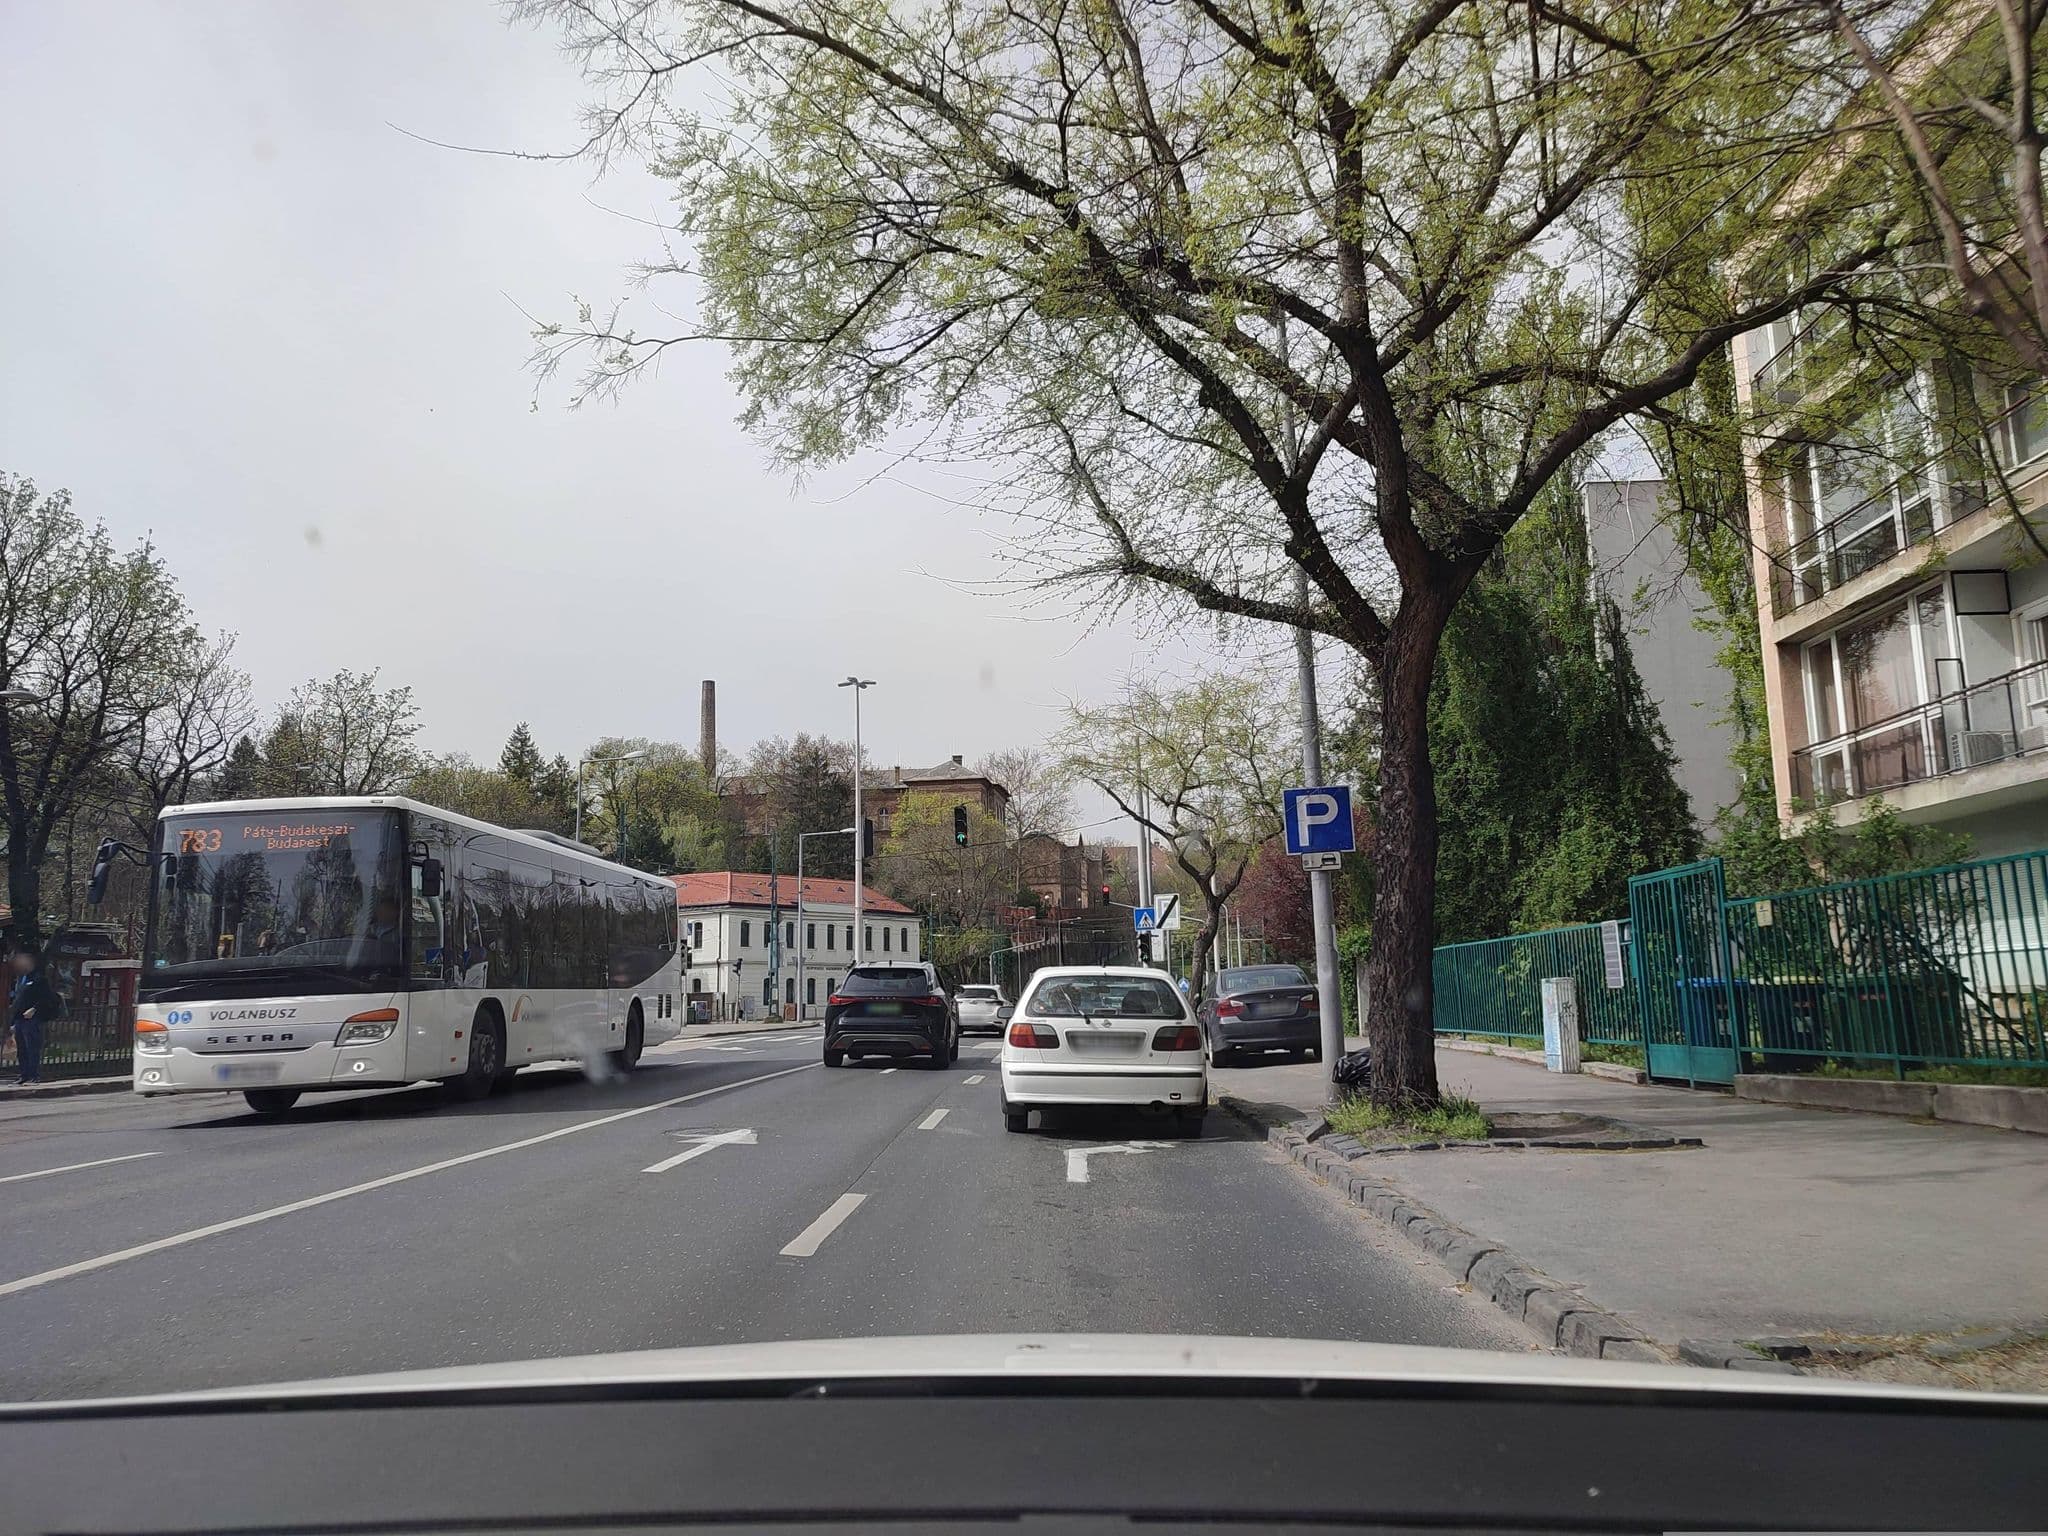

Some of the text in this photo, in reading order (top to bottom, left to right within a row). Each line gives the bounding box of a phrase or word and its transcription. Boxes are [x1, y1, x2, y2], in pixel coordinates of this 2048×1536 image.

[1296, 794, 1338, 846] P
[179, 828, 222, 853] 783
[267, 836, 329, 849] Budapest
[207, 1033, 293, 1044] SETRA
